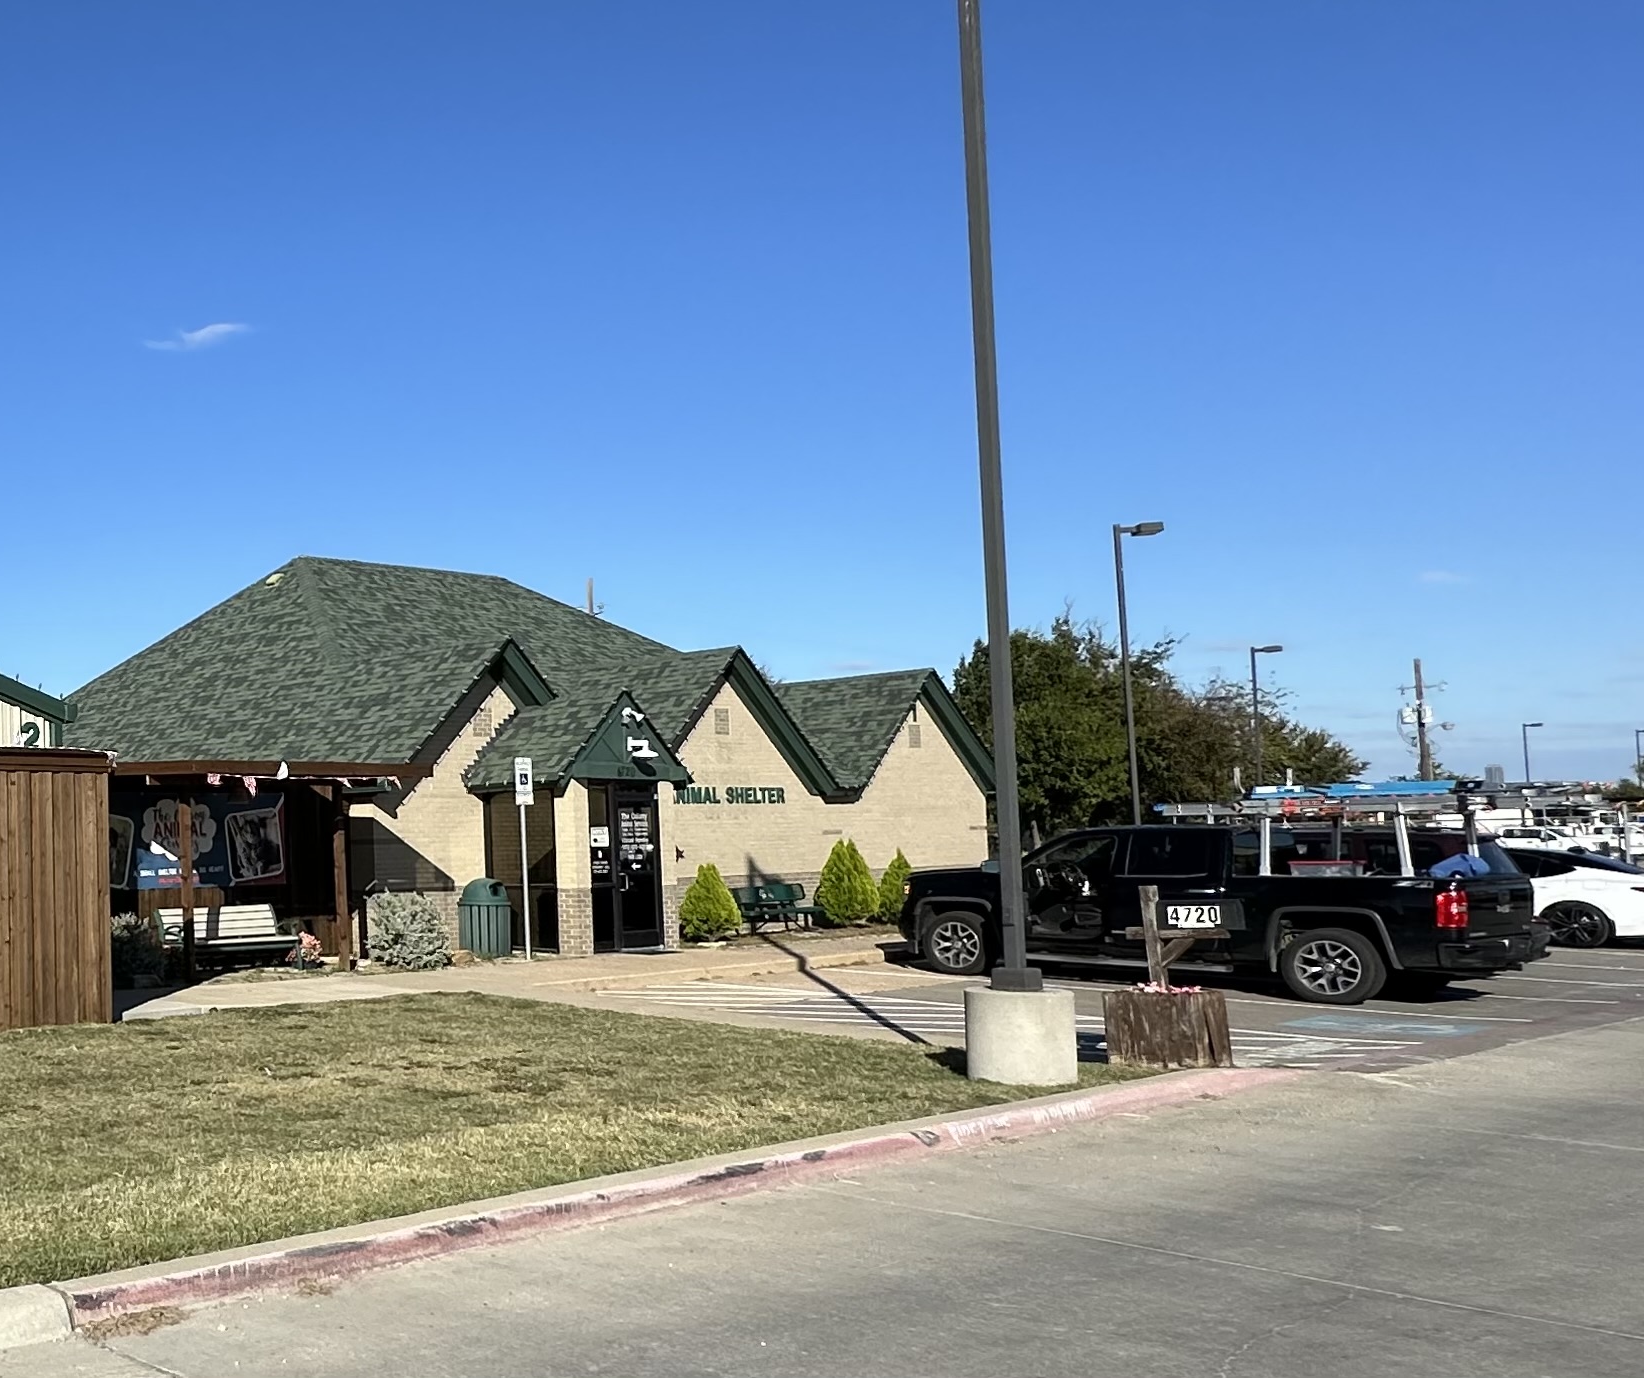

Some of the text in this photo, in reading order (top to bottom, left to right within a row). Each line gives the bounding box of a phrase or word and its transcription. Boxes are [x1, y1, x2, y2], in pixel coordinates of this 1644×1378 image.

[20, 721, 40, 747] 2
[725, 786, 785, 805] SHELTER
[154, 822, 206, 837] ANIAL
[1169, 906, 1218, 923] 4720
